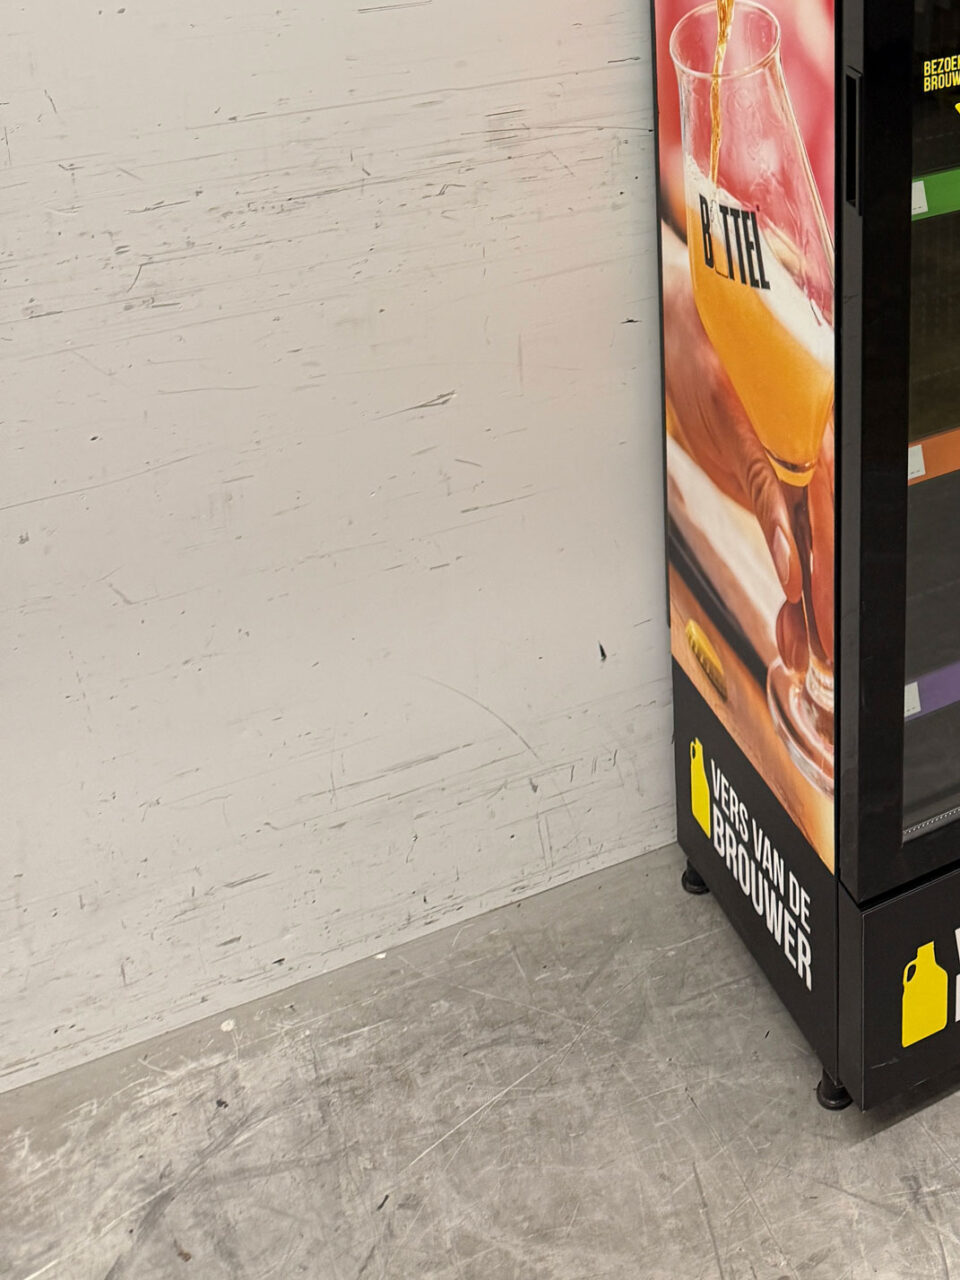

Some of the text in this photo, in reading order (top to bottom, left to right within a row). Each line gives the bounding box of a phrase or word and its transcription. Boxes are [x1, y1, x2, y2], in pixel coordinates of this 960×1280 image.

[710, 758, 811, 934] VERS VAN DE
[712, 803, 812, 992] BROUWER
